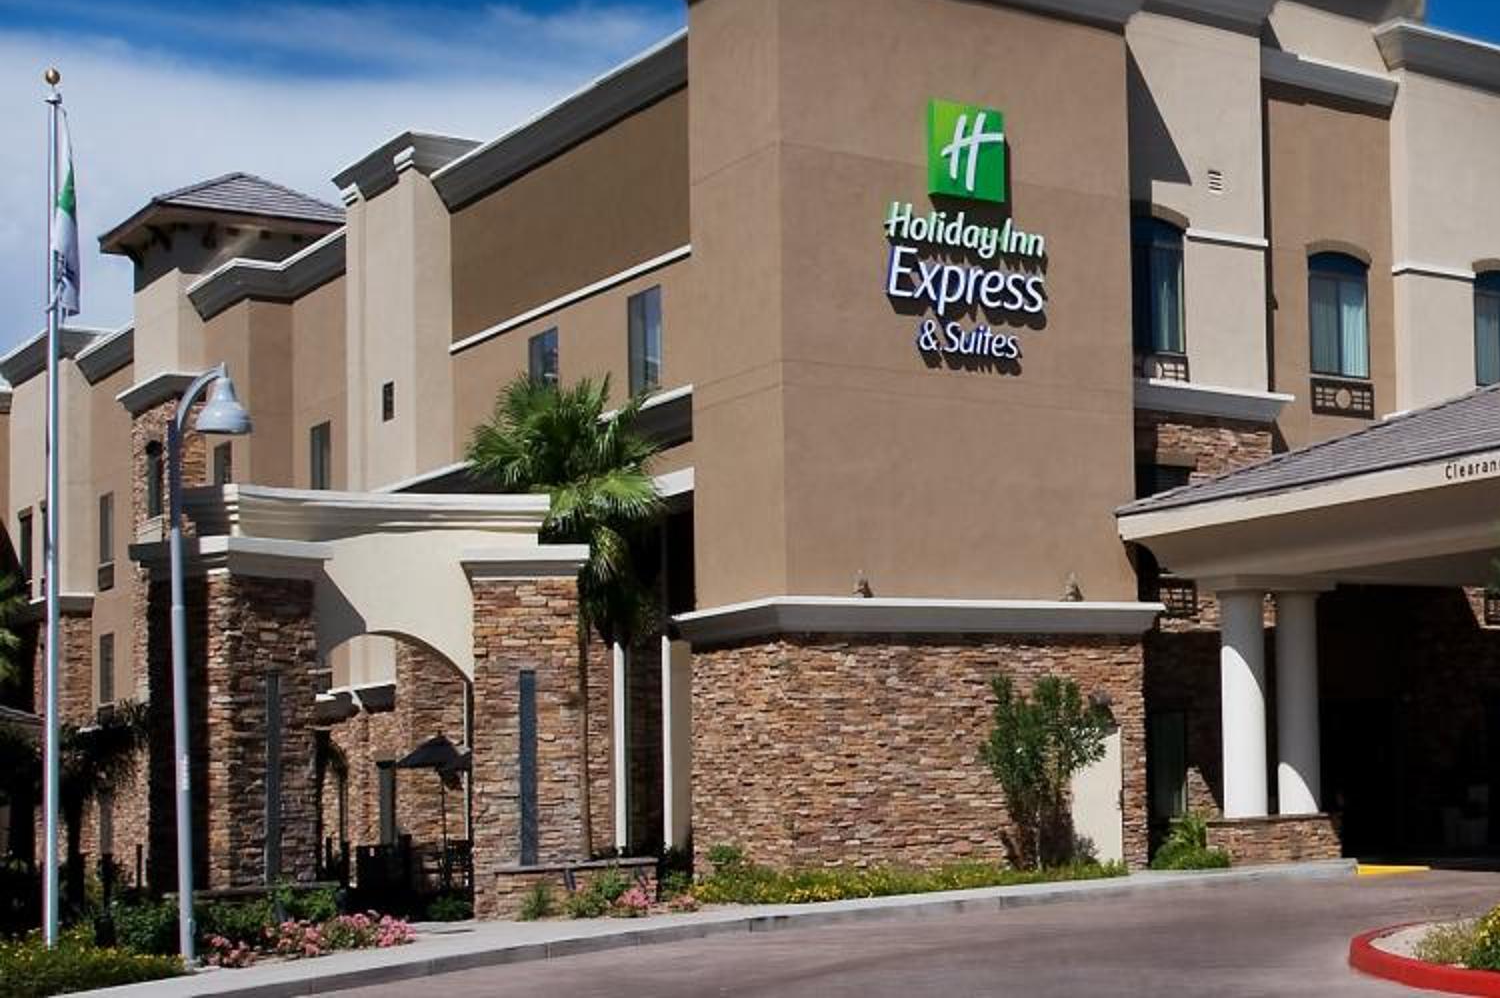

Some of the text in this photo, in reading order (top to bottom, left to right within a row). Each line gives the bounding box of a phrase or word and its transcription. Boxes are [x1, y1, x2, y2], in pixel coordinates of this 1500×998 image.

[886, 201, 1044, 258] Holiday Inn
[888, 246, 1044, 315] Express
[919, 320, 1019, 359] & Suites
